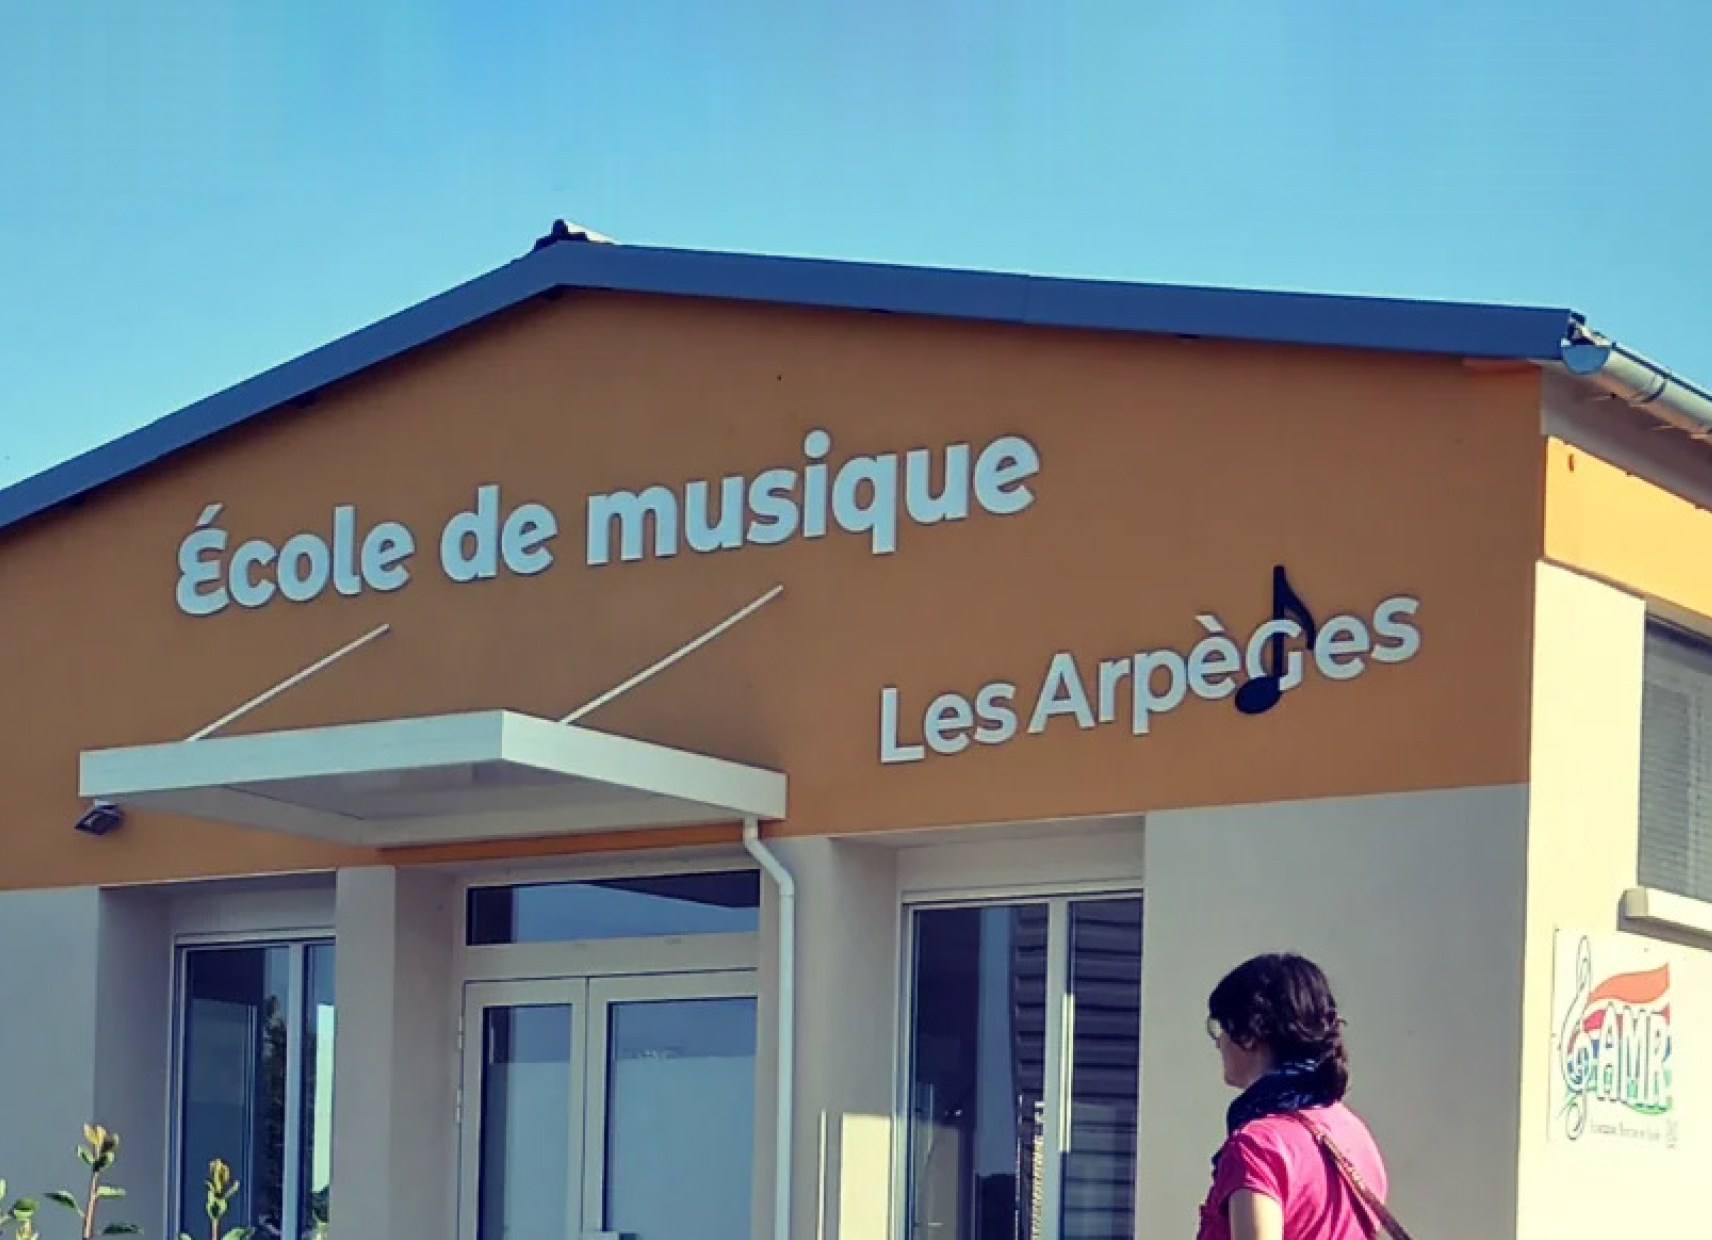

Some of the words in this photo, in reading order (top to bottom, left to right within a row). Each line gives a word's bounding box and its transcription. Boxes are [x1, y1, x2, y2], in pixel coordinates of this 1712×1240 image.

[174, 504, 415, 615] École
[439, 484, 558, 582] de
[586, 430, 1040, 565] musique
[880, 683, 1018, 763] Les
[1596, 1001, 1669, 1111] AMR
